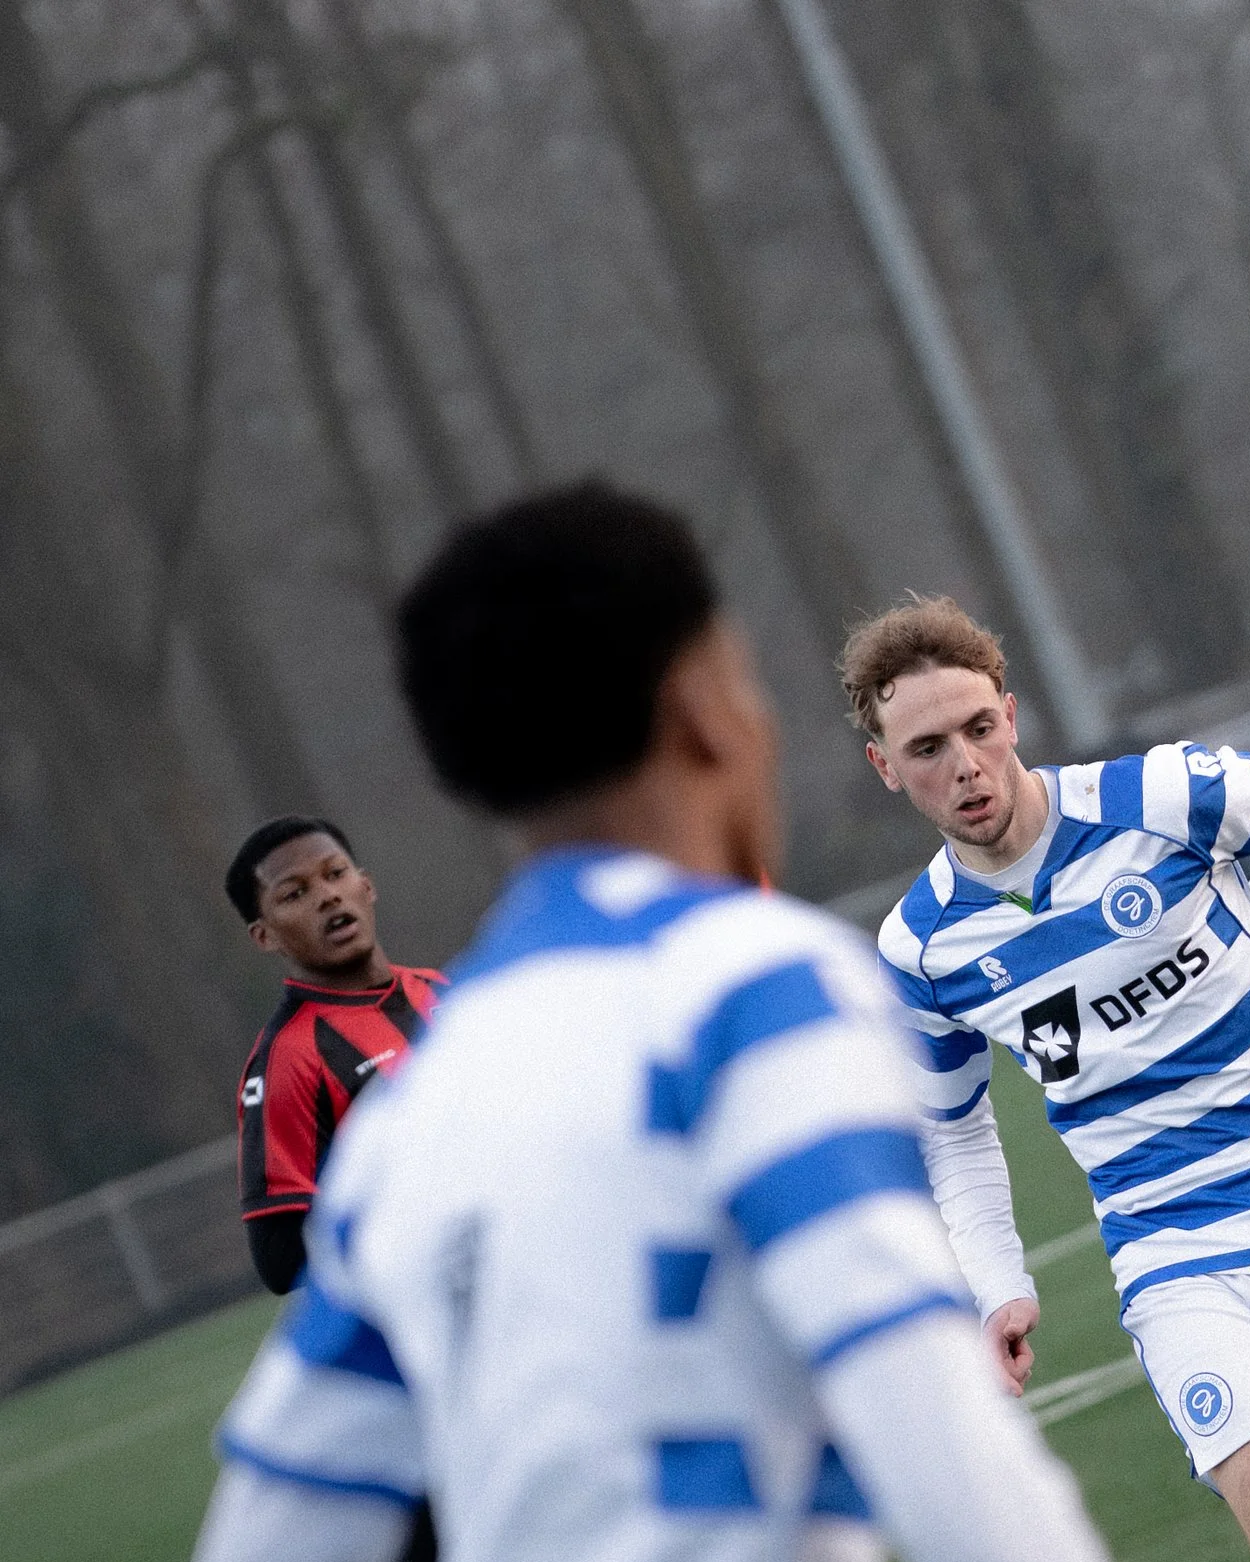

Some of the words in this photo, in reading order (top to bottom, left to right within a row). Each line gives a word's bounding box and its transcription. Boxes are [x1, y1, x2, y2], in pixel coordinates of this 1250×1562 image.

[1106, 878, 1153, 898] GRAAFSCHAP
[1117, 908, 1160, 934] DOETINCHEM
[990, 973, 1012, 993] ROBEY
[1089, 937, 1210, 1032] DFDS
